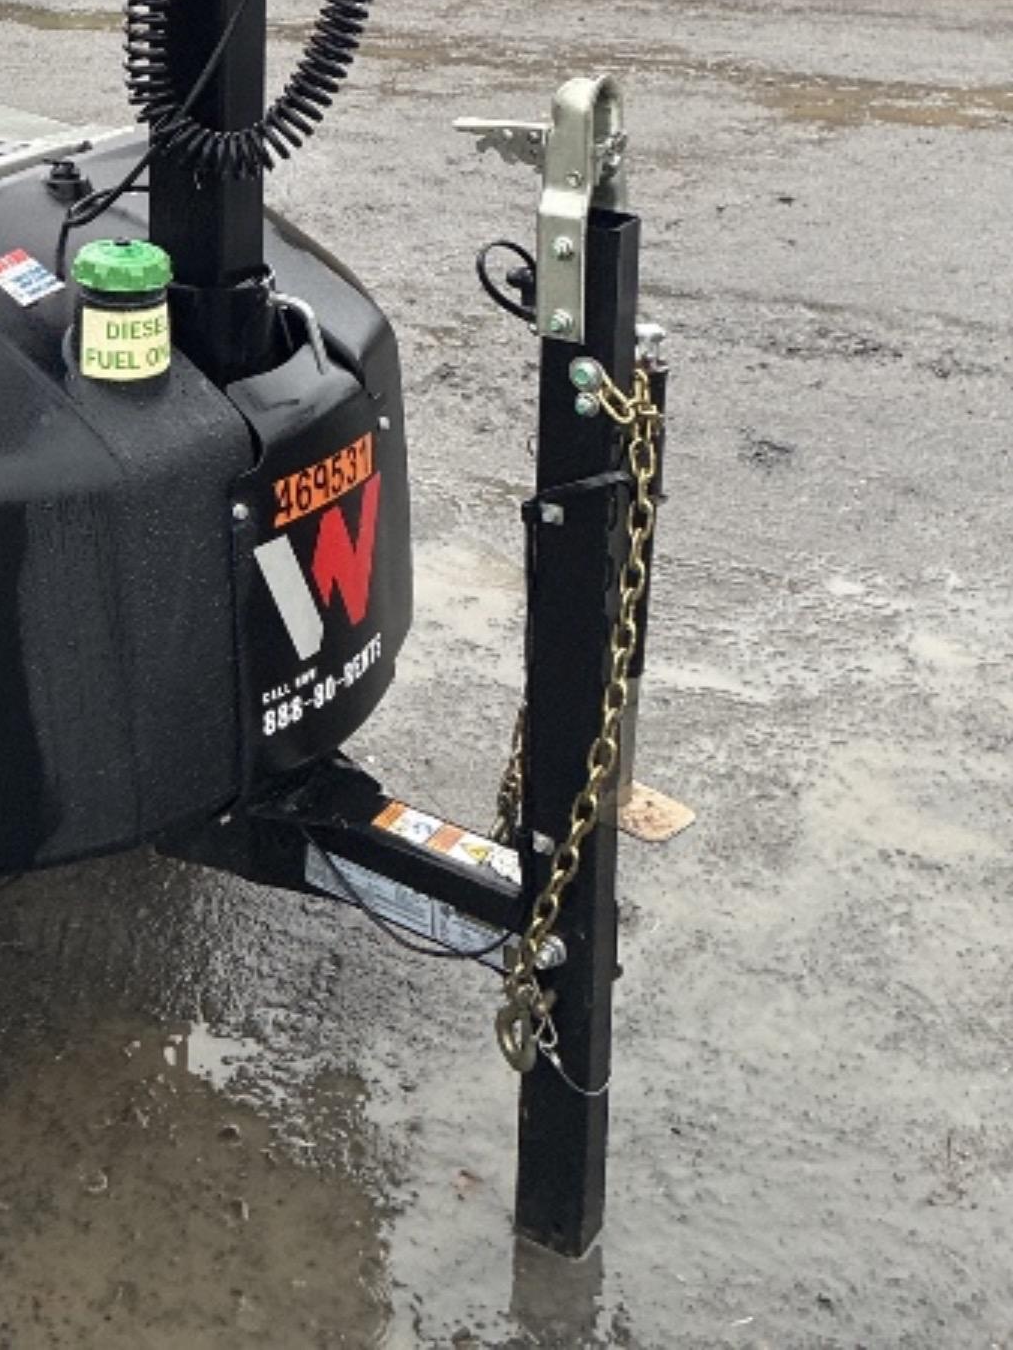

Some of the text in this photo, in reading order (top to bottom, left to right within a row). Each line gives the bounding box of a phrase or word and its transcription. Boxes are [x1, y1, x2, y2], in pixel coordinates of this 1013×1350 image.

[106, 315, 167, 340] DIESE
[85, 346, 141, 370] FUEL
[278, 439, 369, 518] 469531
